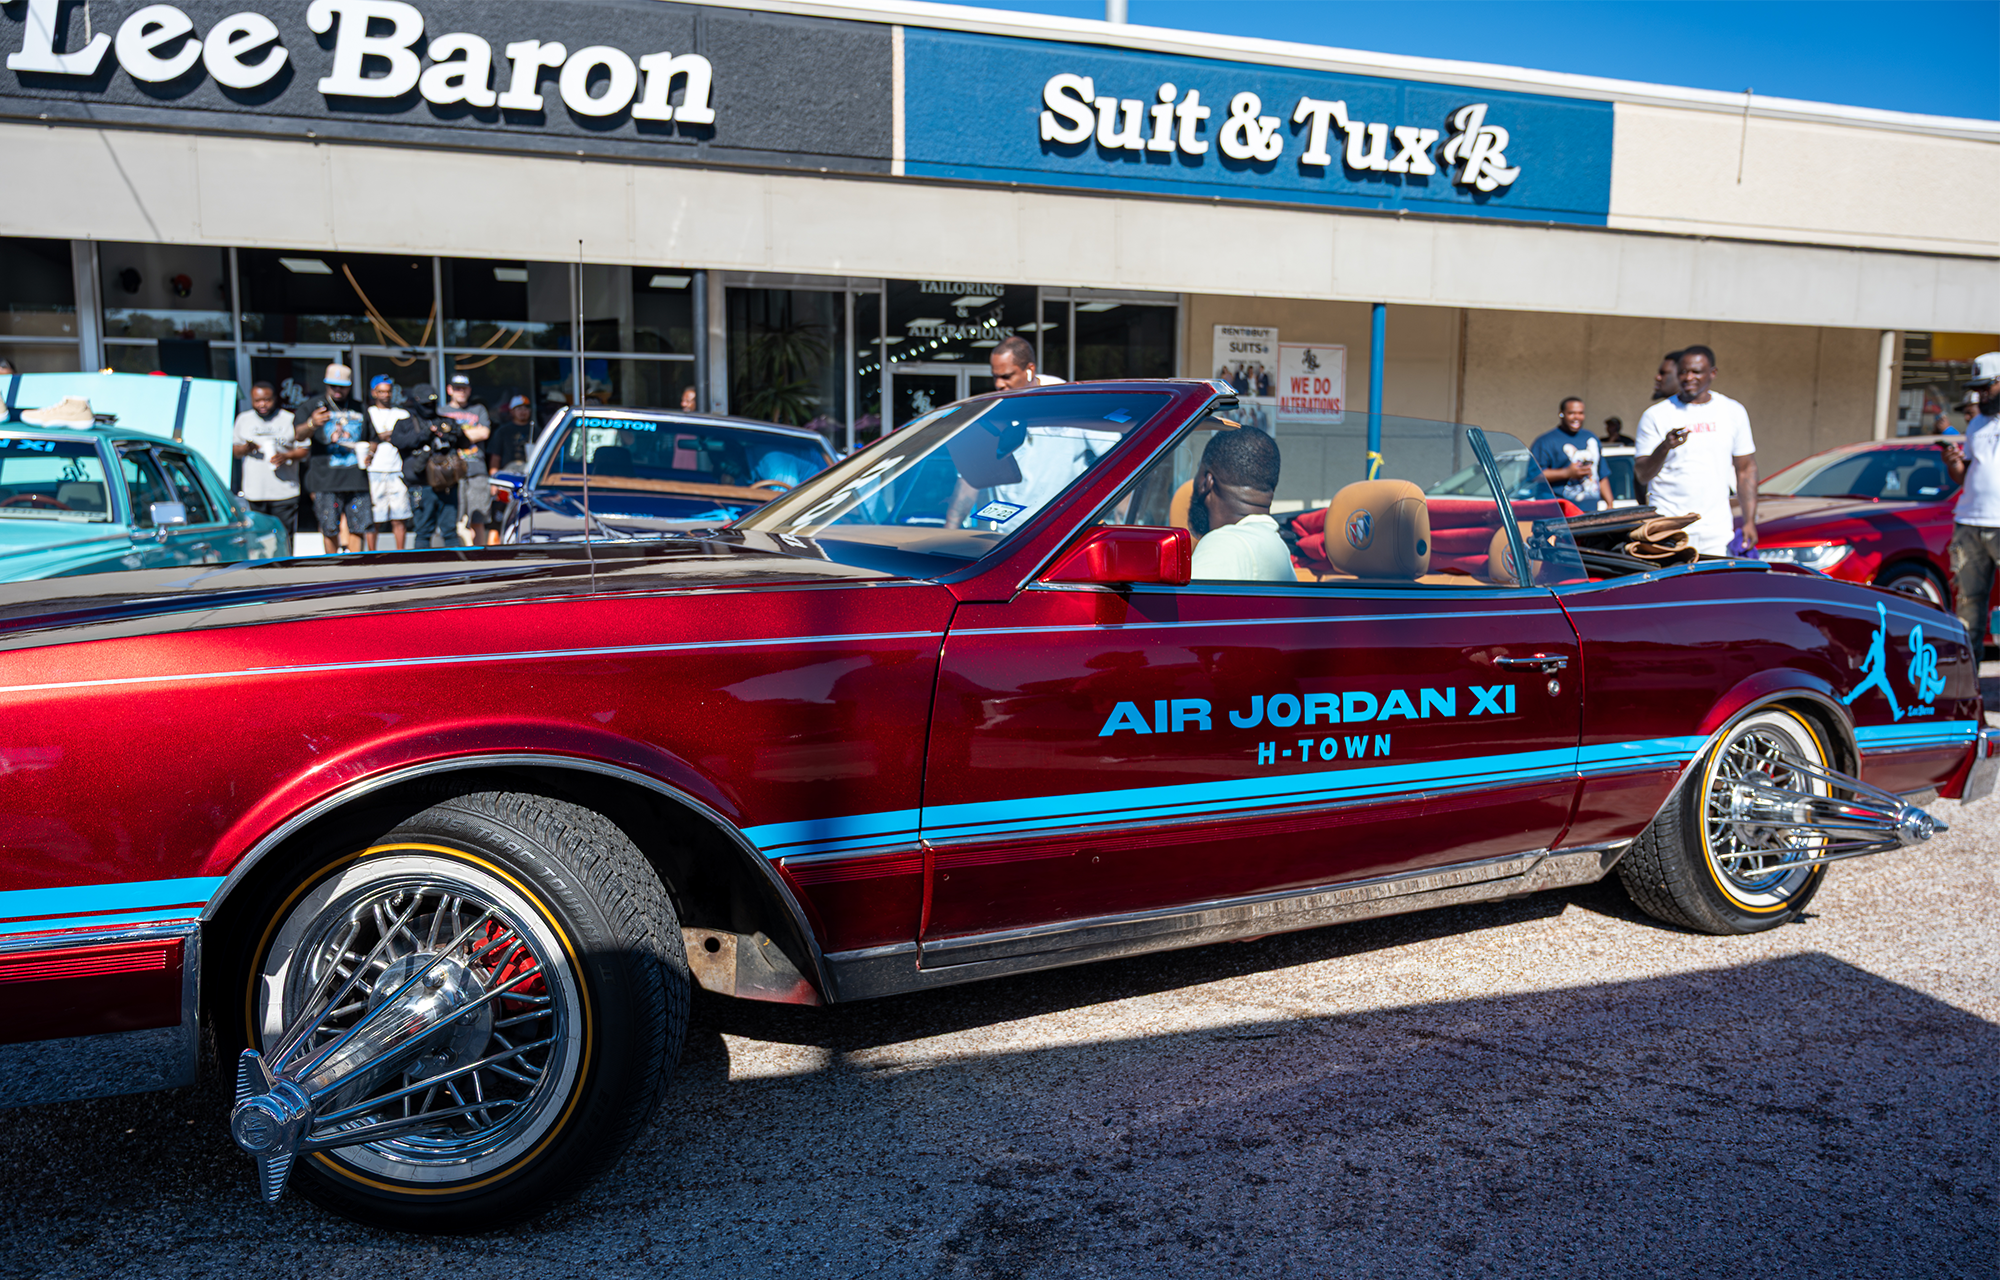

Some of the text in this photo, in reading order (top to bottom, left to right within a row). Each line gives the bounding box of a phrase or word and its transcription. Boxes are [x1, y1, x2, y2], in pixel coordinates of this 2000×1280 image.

[6, 0, 716, 125] Lee Baron
[1040, 73, 1211, 155] Suit
[1219, 91, 1284, 162] &
[1293, 96, 1439, 175] Tux
[918, 280, 1005, 296] TAILORING
[908, 323, 1014, 340] ALTERATIONS
[1229, 342, 1262, 354] SUITS
[1290, 376, 1331, 395] WE DO
[1279, 397, 1340, 415] ALTERATIONS
[576, 417, 658, 432] HOUSTON
[1098, 685, 1516, 737] AIR JORDAN XI
[1257, 734, 1391, 765] H-TOWN
